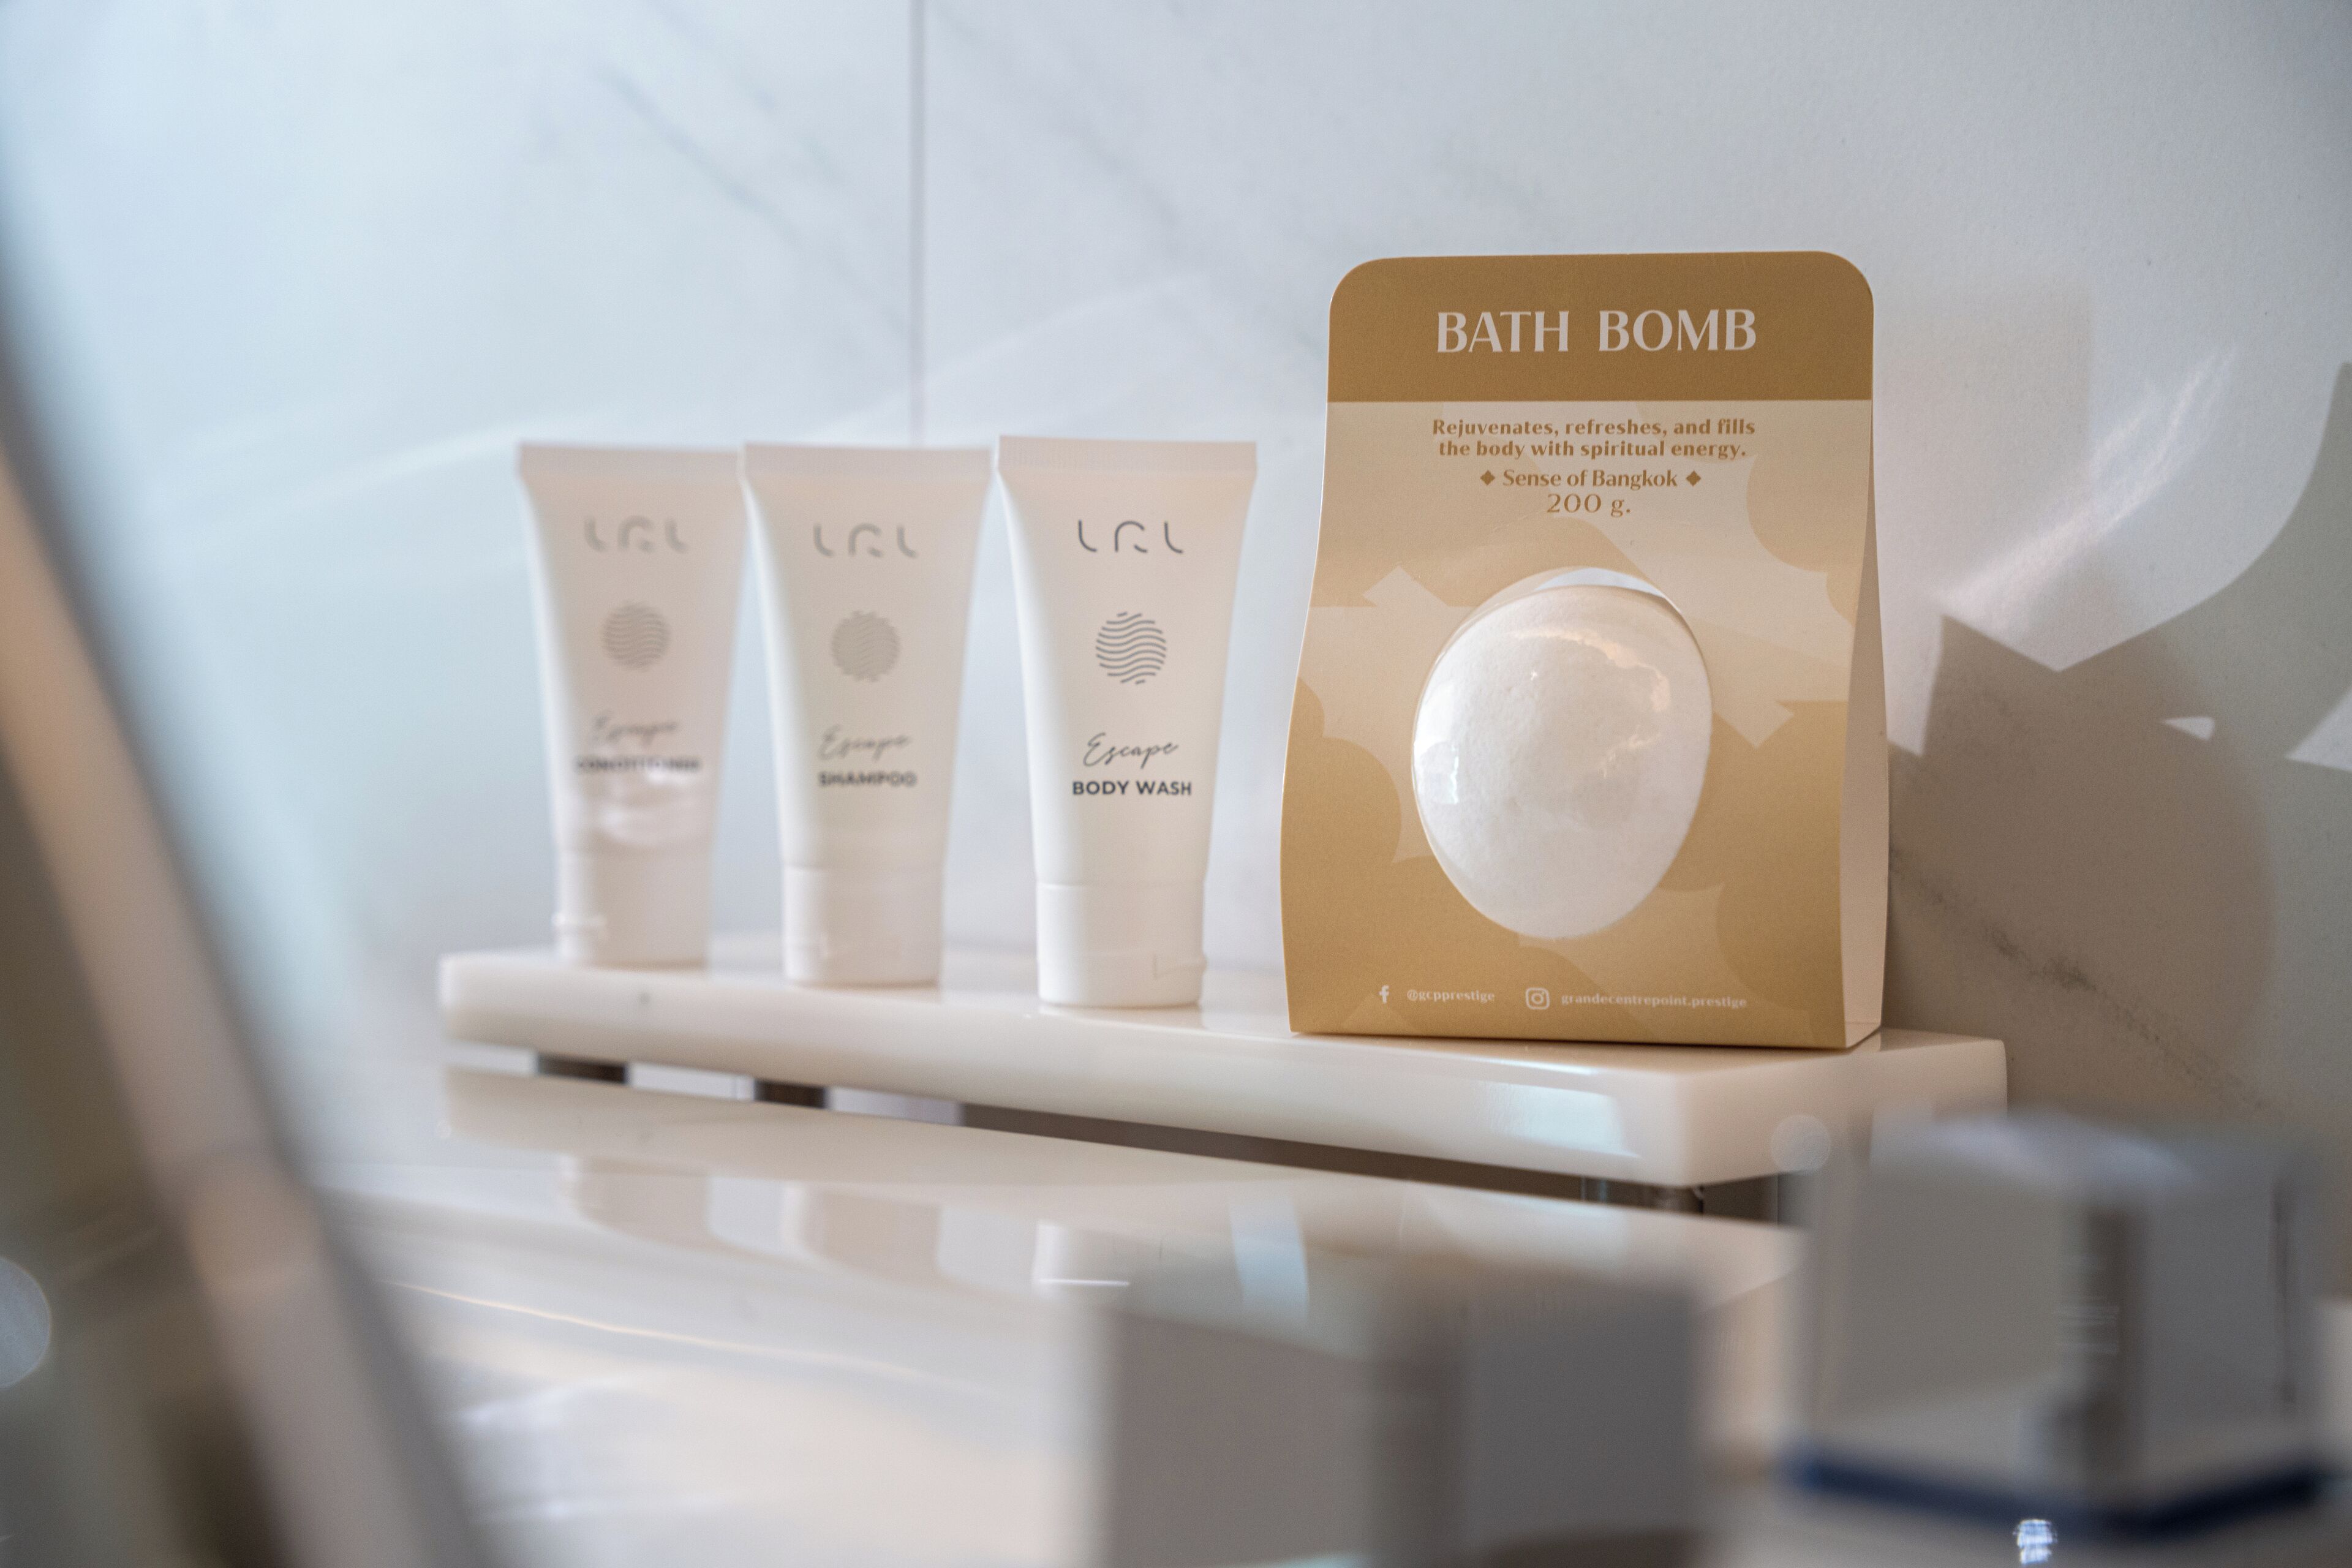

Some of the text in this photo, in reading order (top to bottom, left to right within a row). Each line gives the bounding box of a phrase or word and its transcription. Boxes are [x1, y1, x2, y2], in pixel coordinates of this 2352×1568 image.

[1437, 309, 1757, 353] BATH BOMB
[1433, 418, 1755, 437] Rejuvenates, refreshes, and fills
[1439, 440, 1746, 459] the body with spiritual energy.
[1502, 469, 1678, 489] Sense of Bangkok
[1547, 494, 1631, 517] 200 g.
[1083, 733, 1179, 769] Escape
[819, 771, 918, 787] SHAMPOO
[1072, 781, 1192, 796] BODY WASH
[1407, 990, 1494, 1003] @gcpprestige
[1561, 993, 1747, 1009] grandecentrepoint.prestige
